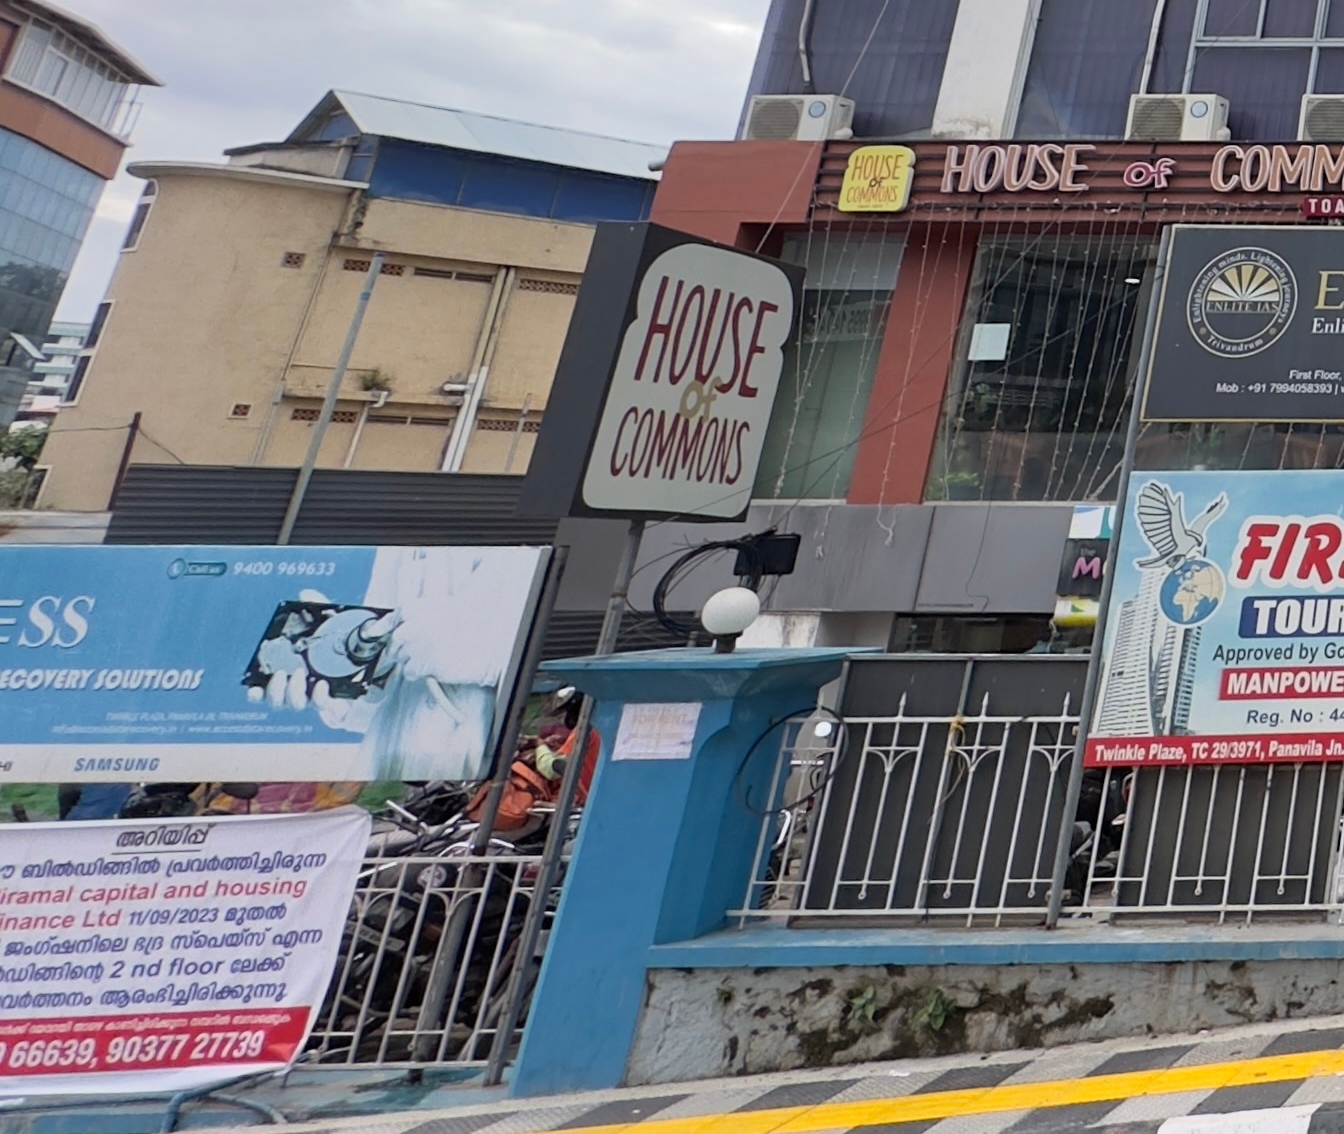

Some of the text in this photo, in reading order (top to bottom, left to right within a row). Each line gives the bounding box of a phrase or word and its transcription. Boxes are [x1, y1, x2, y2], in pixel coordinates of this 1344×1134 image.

[851, 154, 904, 180] HOUSE
[940, 143, 1096, 193] HOUSE
[1123, 156, 1177, 189] of
[846, 184, 899, 204] COMMONS
[1206, 301, 1279, 313] ENLITE IAS
[634, 275, 779, 398] HOUSE
[1207, 334, 1264, 353] Trivandrum
[1289, 369, 1312, 380] First
[1314, 369, 1342, 382] Floor,
[1216, 383, 1239, 393] Mob
[1247, 383, 1267, 393] +91
[679, 376, 723, 424] of
[610, 406, 750, 486] COMMONS
[233, 561, 274, 575] 9400
[277, 561, 336, 575] 969633
[1212, 642, 1294, 665] Approved
[1299, 642, 1319, 664] by
[94, 667, 204, 691] SOLUTIONS
[1246, 708, 1314, 728] Reg. No
[1094, 744, 1146, 762] Twinkle
[1148, 742, 1188, 763] Plaze,
[1191, 742, 1210, 759] TC
[1210, 740, 1266, 761] 29/3971,
[1268, 739, 1323, 757] Panavila
[74, 757, 161, 772] SAMSUNG
[79, 877, 308, 906] capital and housing
[82, 908, 122, 928] Ltd
[128, 907, 219, 927] 11/09/2023
[109, 964, 123, 979] 2
[130, 961, 161, 978] nd
[167, 957, 226, 977] floor
[9, 1037, 98, 1069] 66639,
[105, 1032, 189, 1065] 90377
[190, 1030, 266, 1060] 27739
